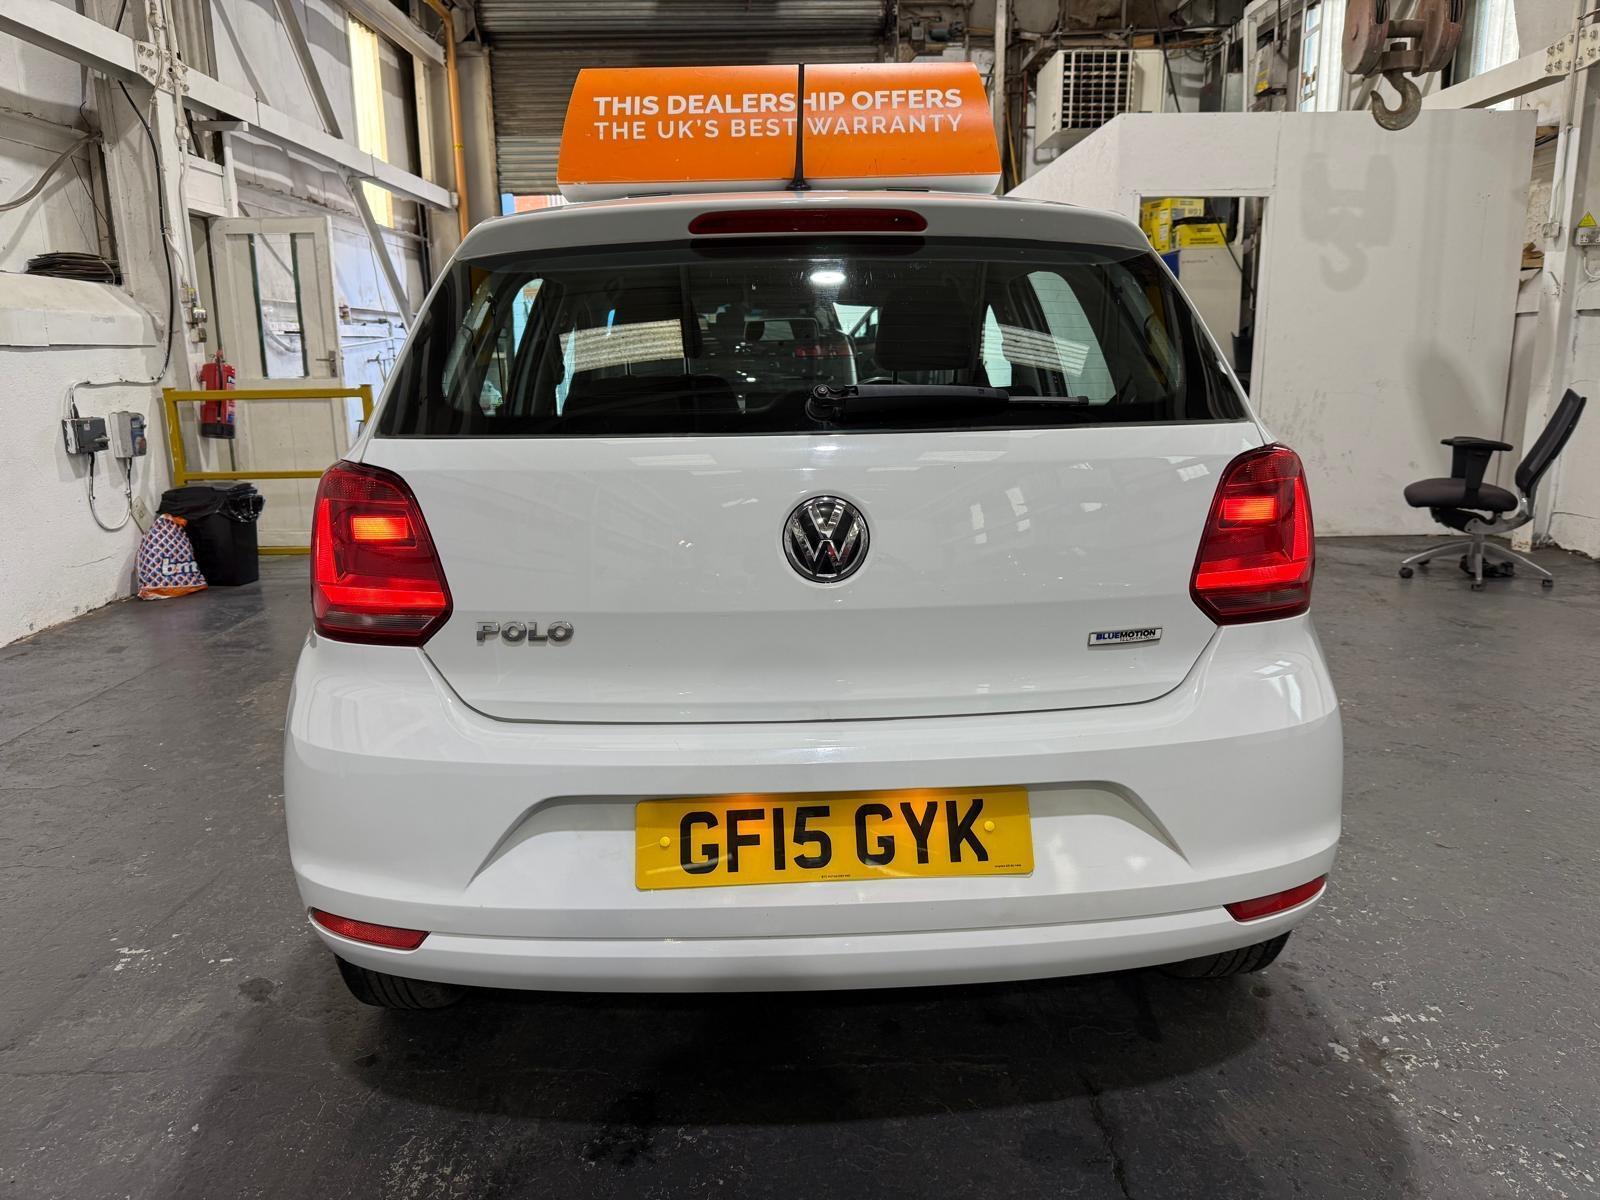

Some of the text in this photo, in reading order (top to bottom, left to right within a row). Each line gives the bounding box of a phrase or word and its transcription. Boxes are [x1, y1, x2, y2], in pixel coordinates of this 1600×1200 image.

[593, 88, 963, 116] THIS DEALERSHIP OFFERS
[594, 113, 963, 140] THE UK'S BEST WARRANTY
[476, 620, 575, 644] POLO
[1096, 629, 1156, 640] BLUEMOTION
[679, 798, 989, 875] GF15 GYK
